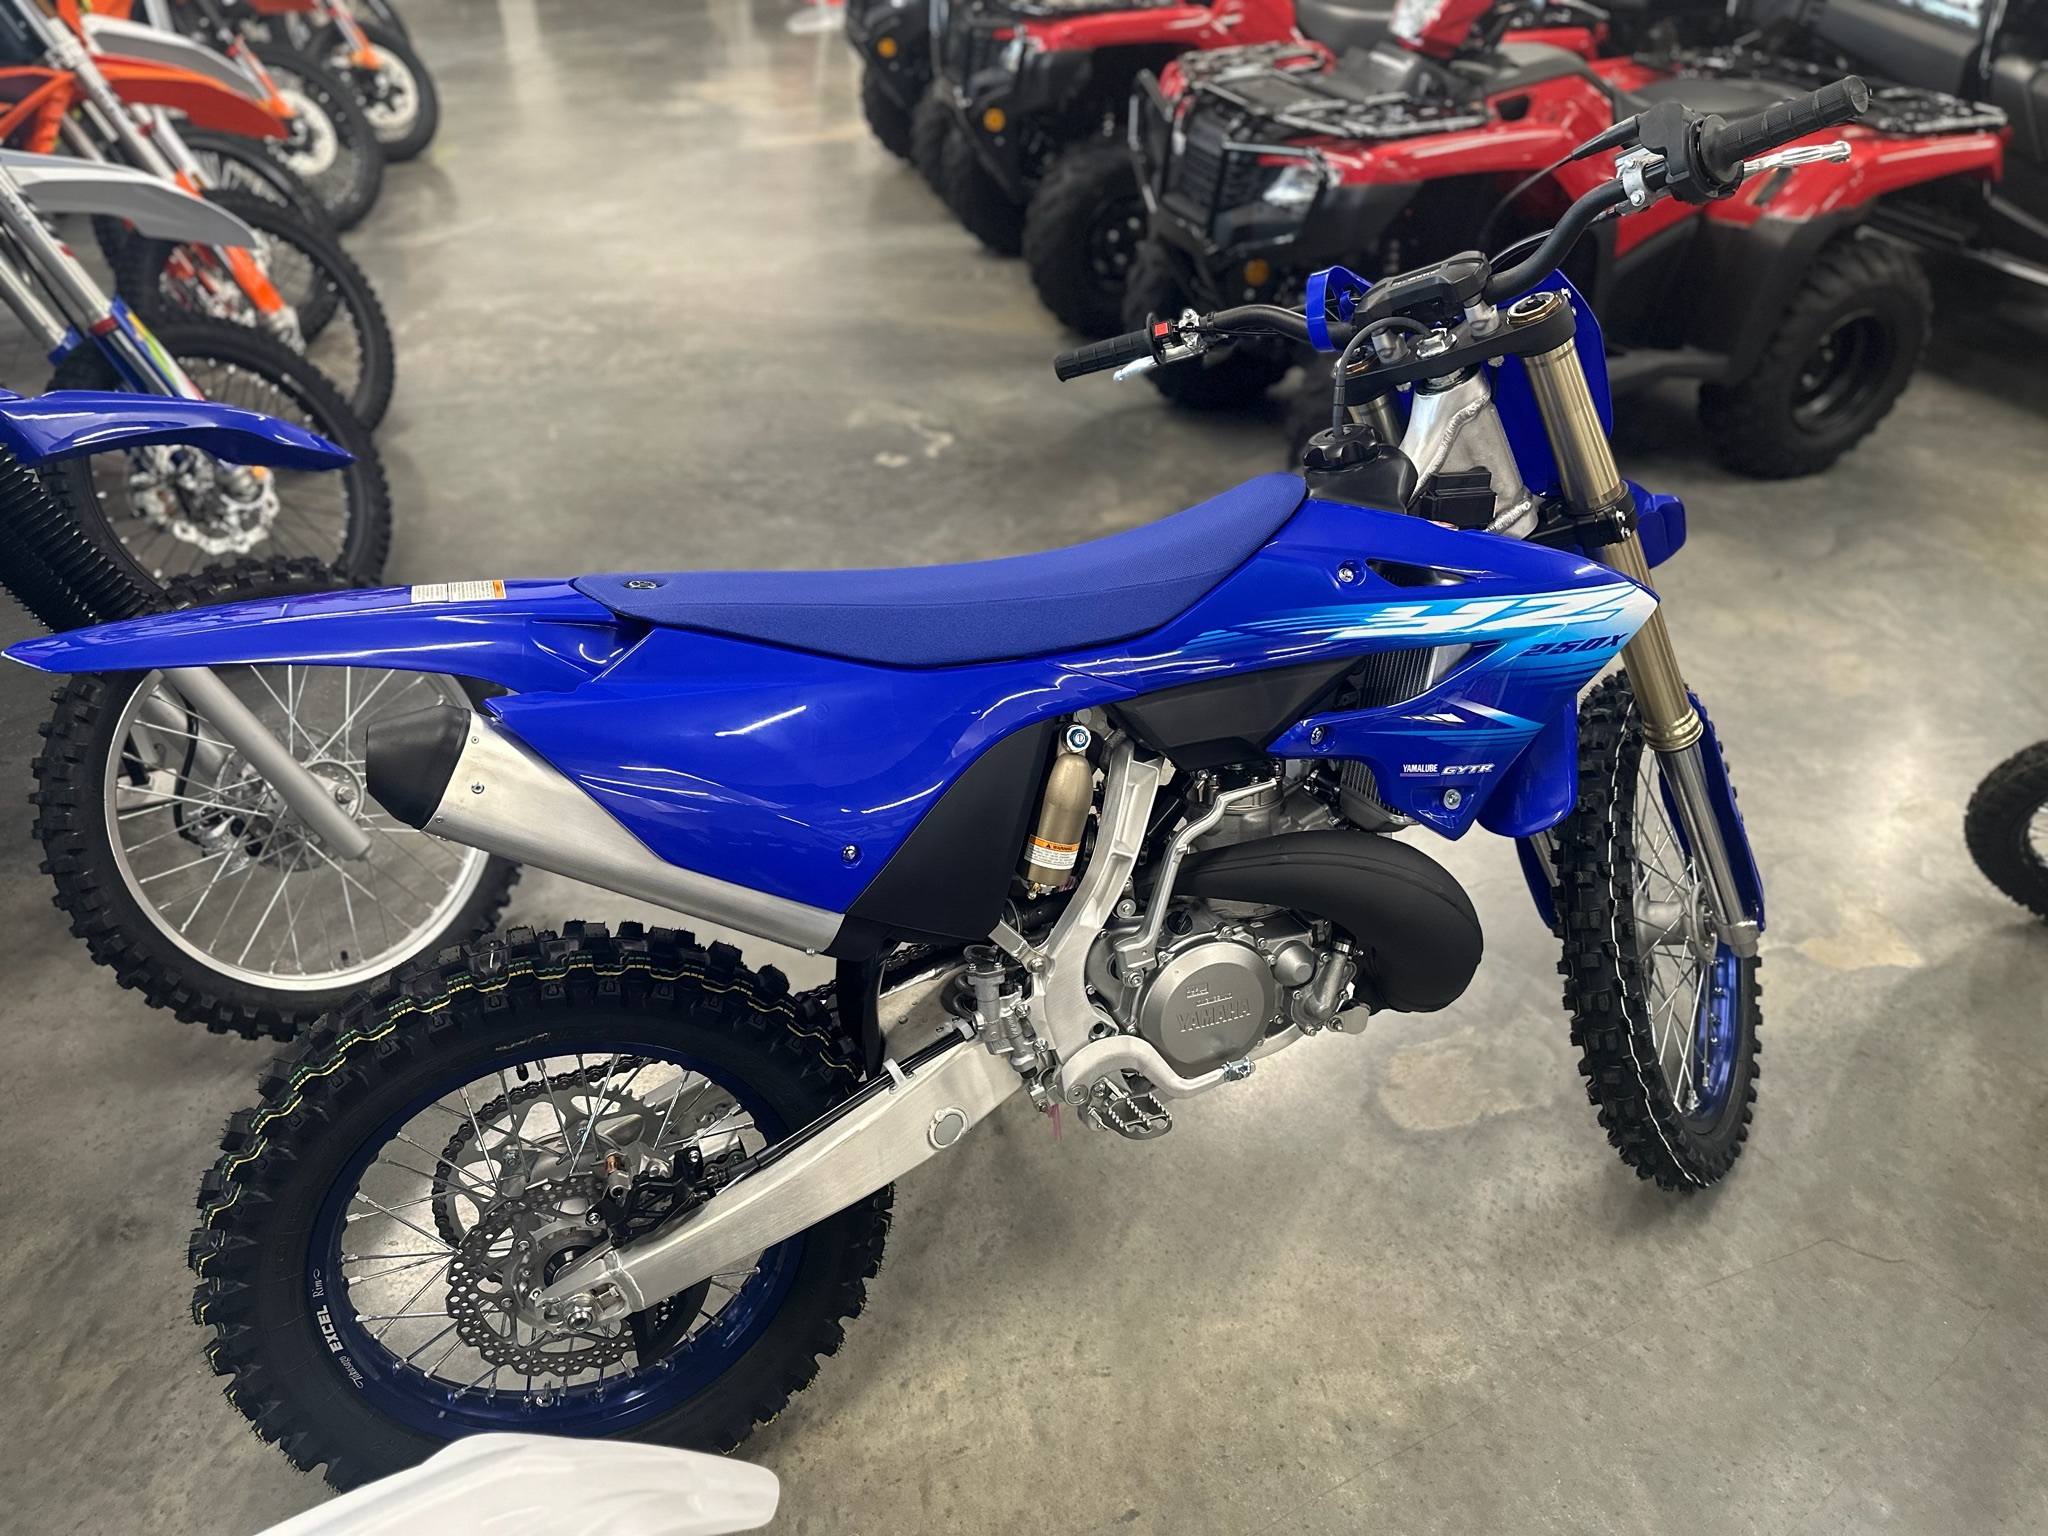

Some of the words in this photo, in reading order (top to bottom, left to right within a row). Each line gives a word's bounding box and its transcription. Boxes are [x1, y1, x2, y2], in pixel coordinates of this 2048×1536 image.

[1322, 584, 1637, 641] YZ
[1518, 633, 1629, 657] 250X
[1403, 764, 1438, 773] YAMALUBE
[1441, 763, 1496, 775] GYTR
[1177, 999, 1251, 1032] YAMAHA
[312, 1268, 325, 1298] Rim
[316, 1305, 344, 1353] EXCEL
